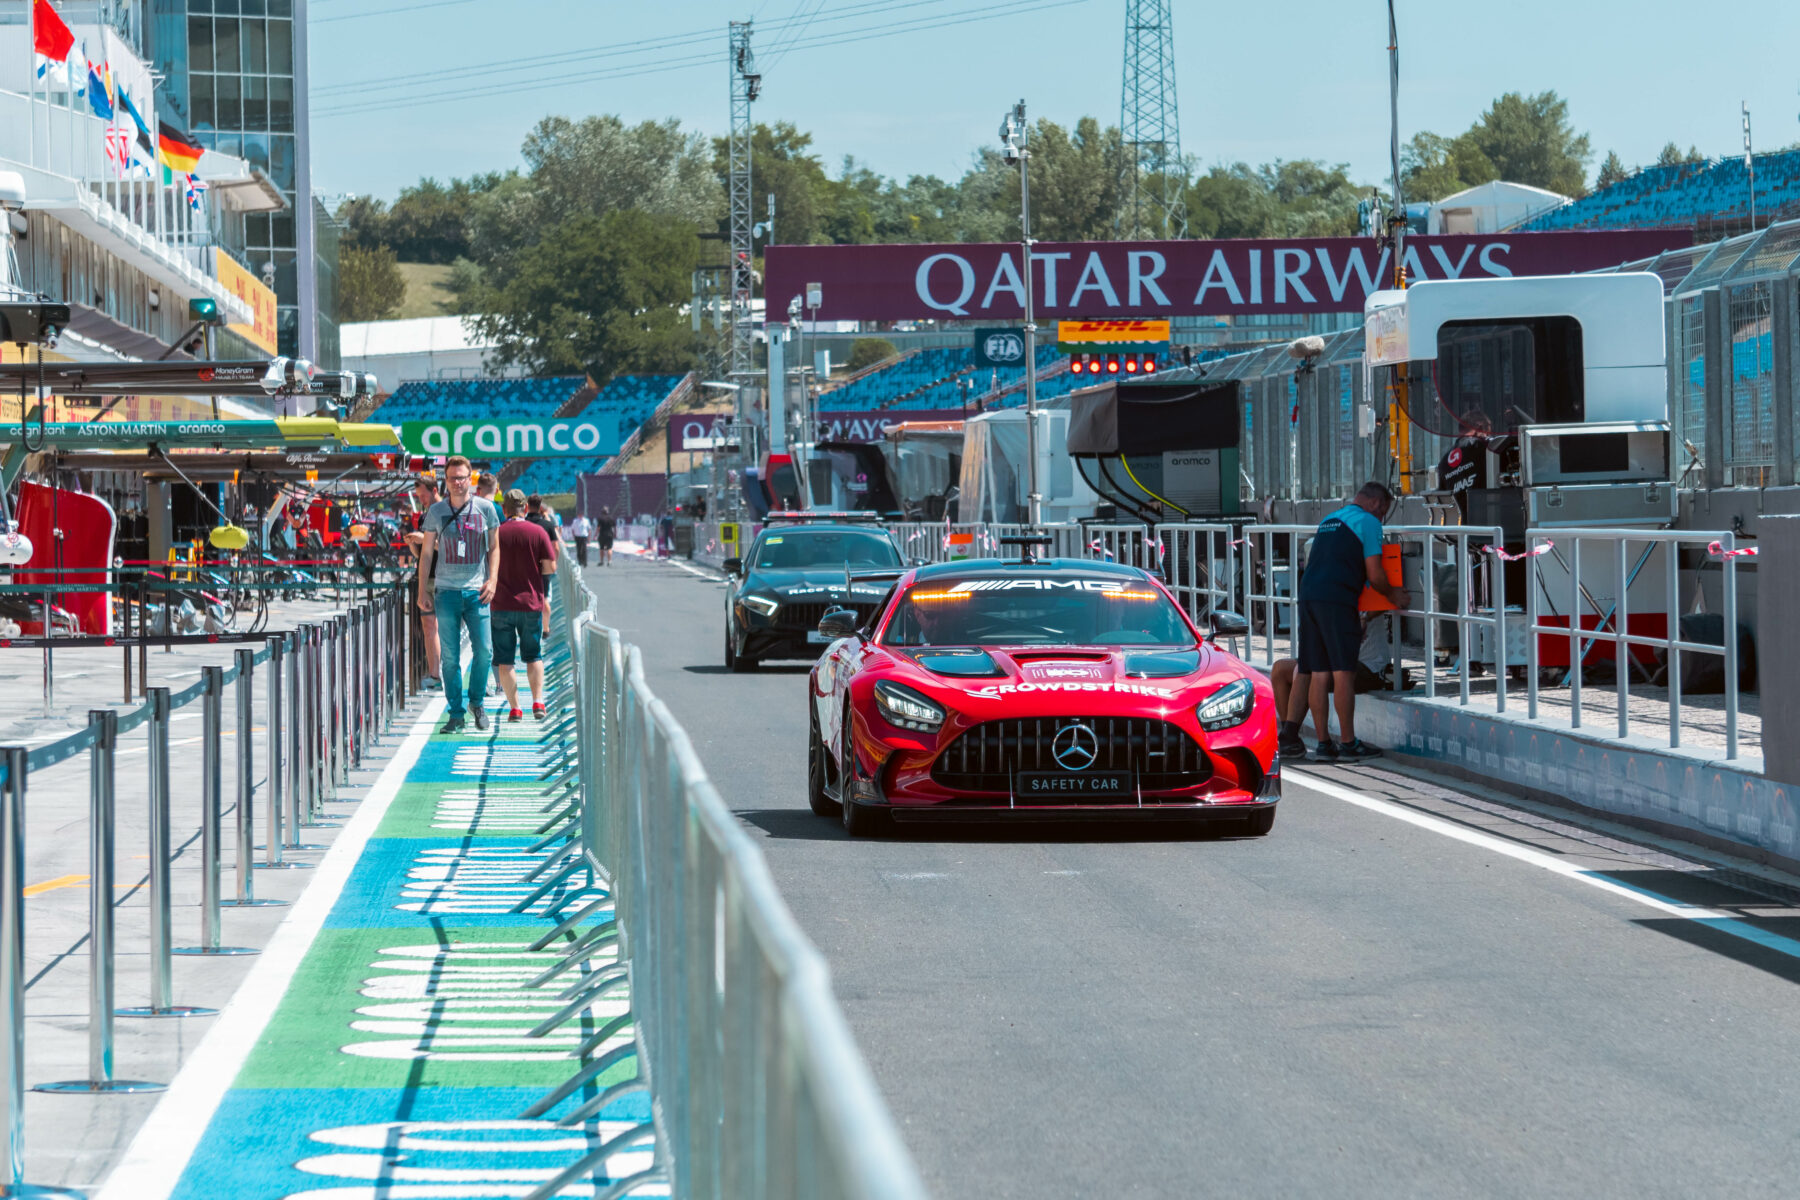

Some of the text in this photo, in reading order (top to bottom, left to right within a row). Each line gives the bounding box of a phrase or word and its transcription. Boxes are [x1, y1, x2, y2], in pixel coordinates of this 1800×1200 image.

[915, 251, 1172, 316] QATAR
[215, 367, 254, 375] MoneyGram
[78, 425, 118, 436] ASTON
[120, 424, 167, 435] MARTIN
[178, 424, 225, 434] aramco
[421, 423, 600, 454] aramco
[1171, 457, 1211, 466] aramco
[788, 587, 825, 595] Race
[1005, 580, 1124, 592] AMG
[980, 682, 1173, 698] CROWDSTRIKE
[1031, 779, 1119, 790] SAFETY CAR
